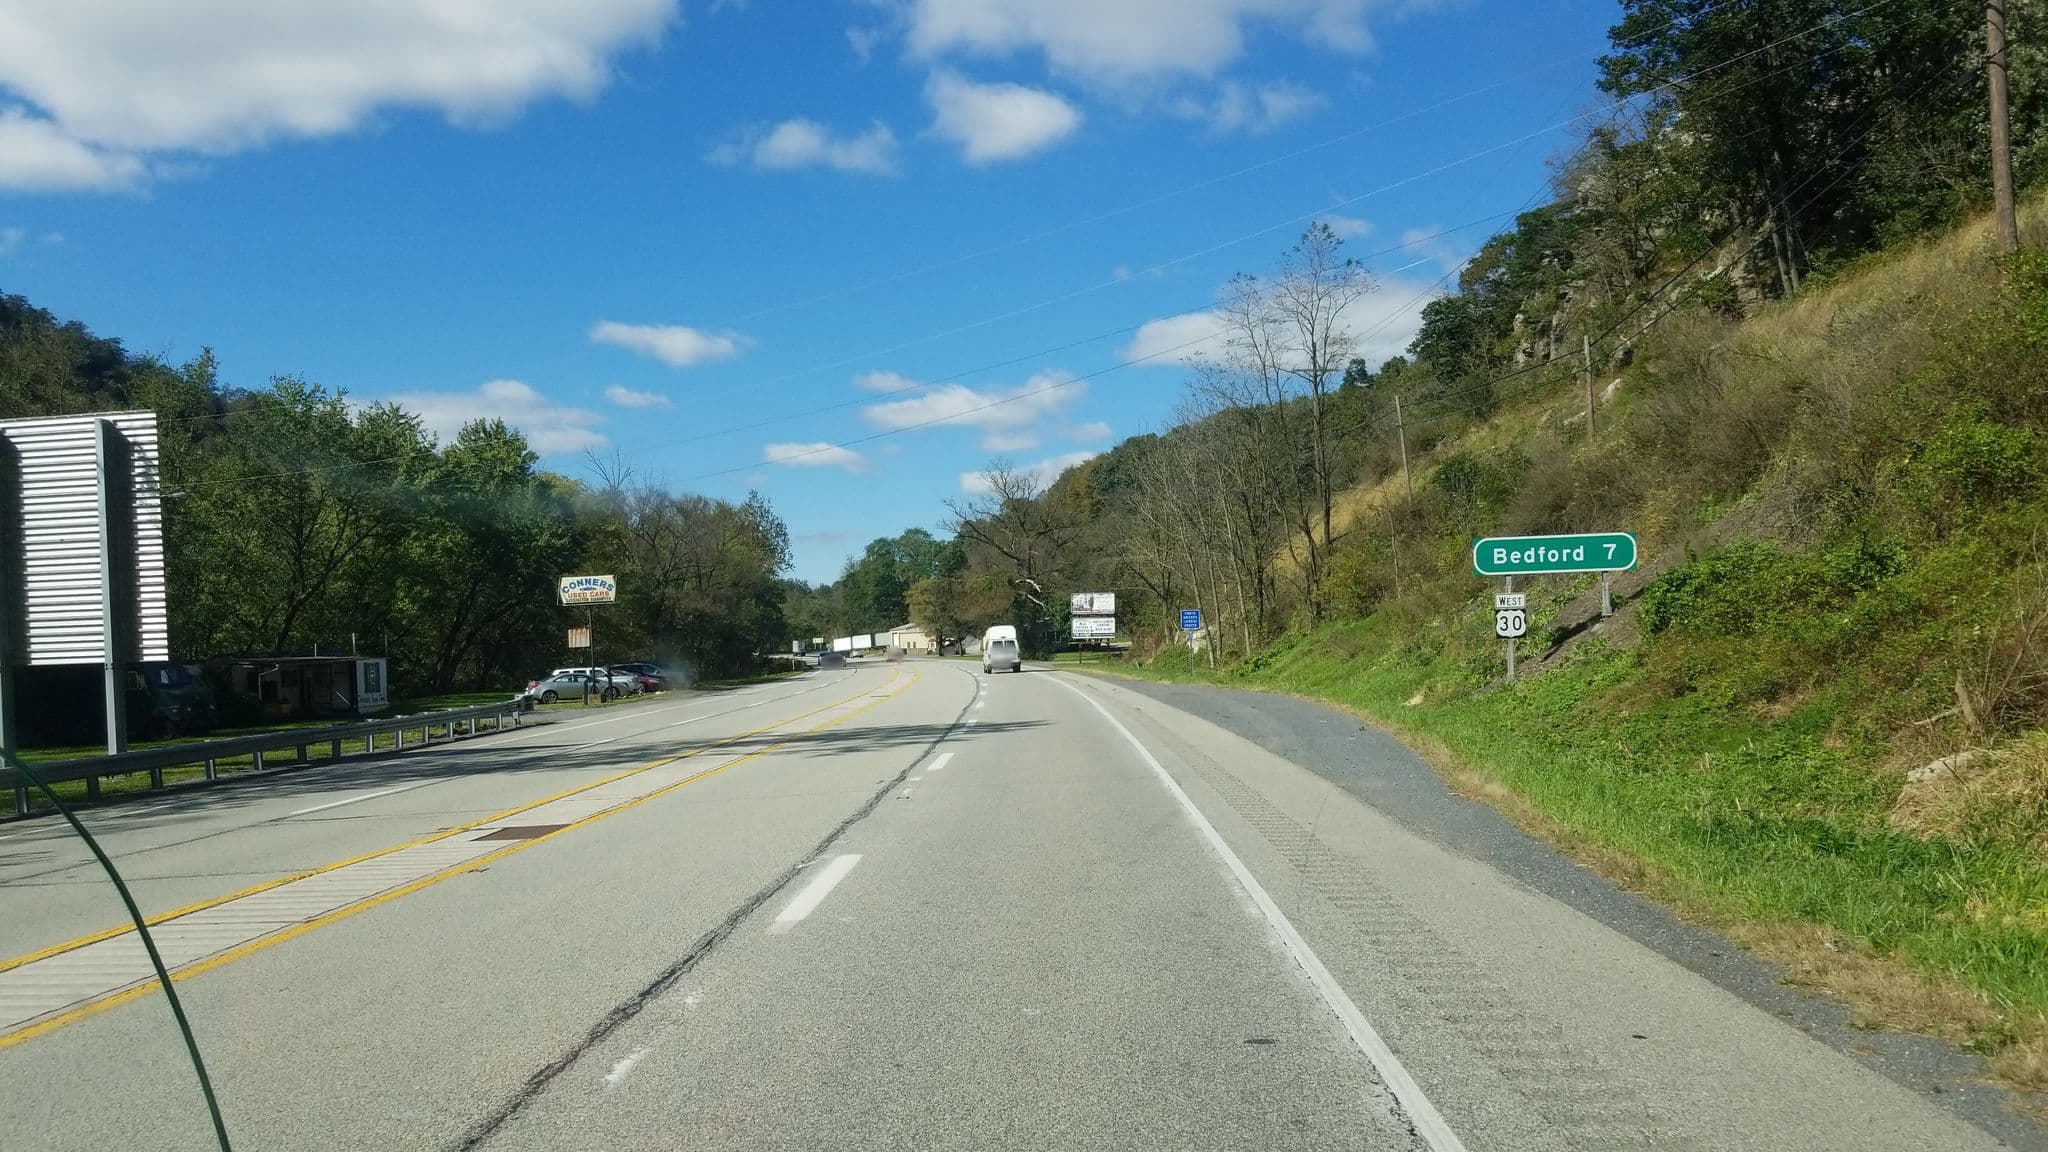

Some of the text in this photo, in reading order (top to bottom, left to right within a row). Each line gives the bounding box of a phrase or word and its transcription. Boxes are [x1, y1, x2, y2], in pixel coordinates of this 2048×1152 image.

[1493, 543, 1617, 564] Bedford 7
[562, 578, 614, 593] CONNERS
[1498, 596, 1522, 606] WEST
[1499, 615, 1522, 631] 30
